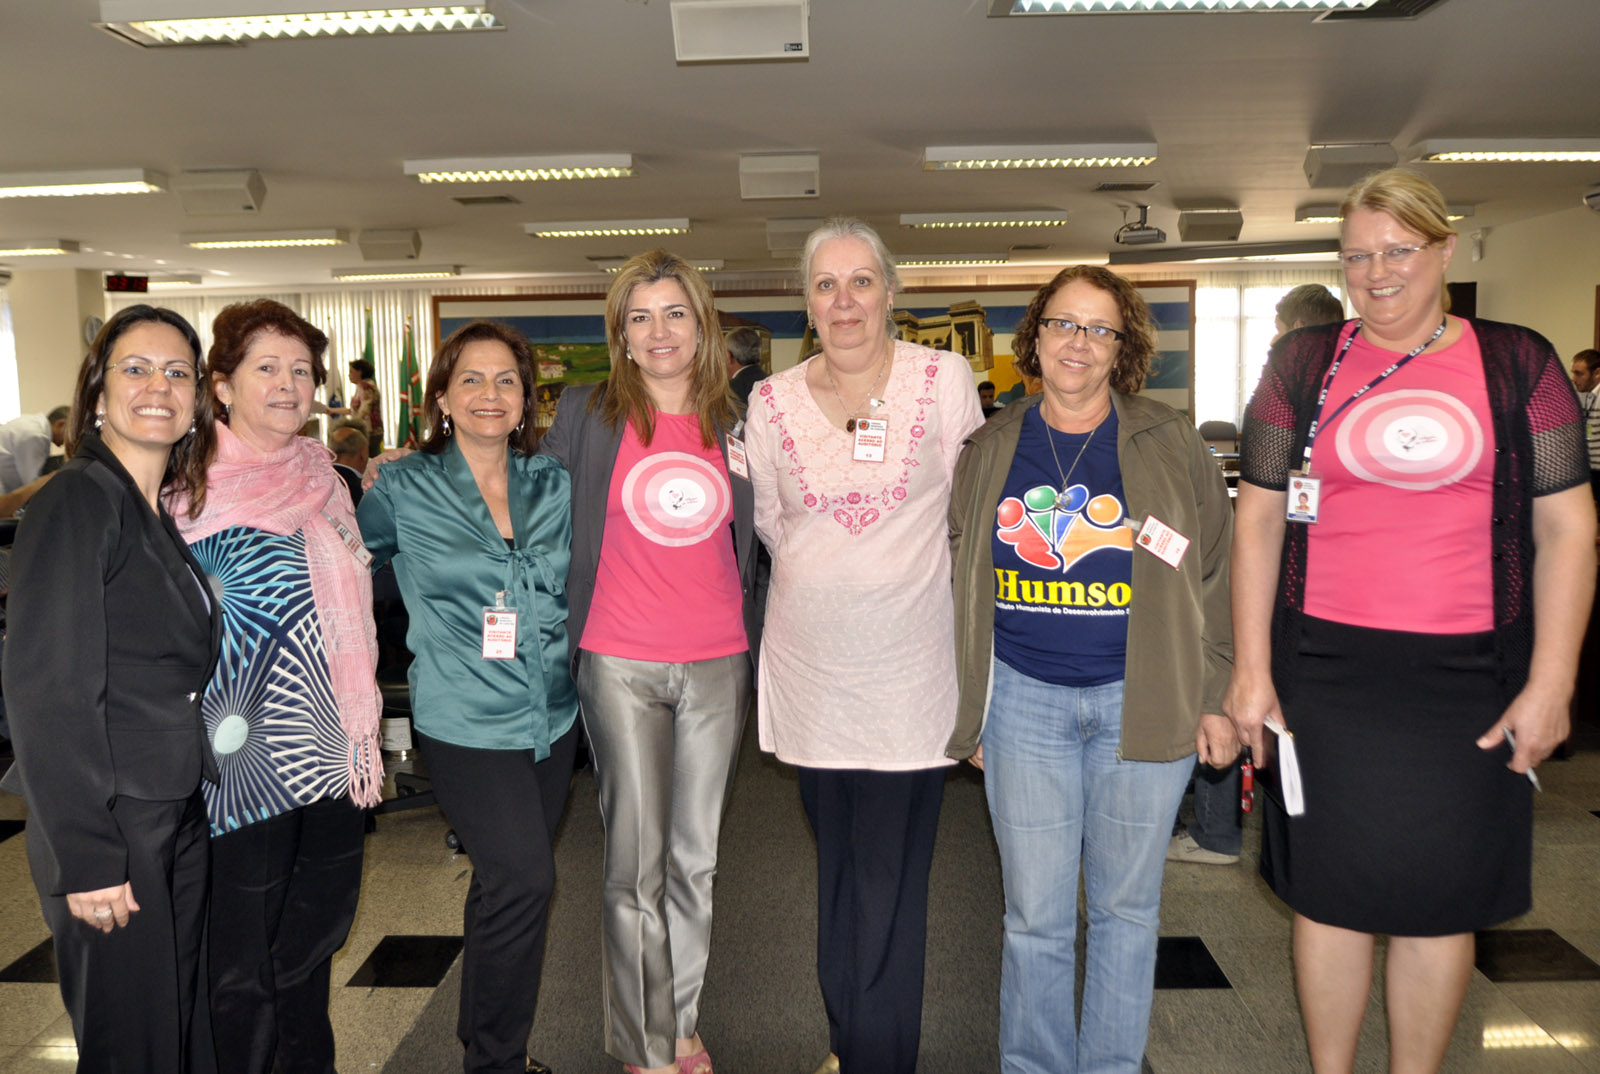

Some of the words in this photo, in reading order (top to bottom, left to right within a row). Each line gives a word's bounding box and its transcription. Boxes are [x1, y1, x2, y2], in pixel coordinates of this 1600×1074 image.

[994, 567, 1131, 607] Humso
[1015, 603, 1052, 614] Humanista
[1052, 606, 1062, 614] de
[1062, 606, 1125, 616] Desenvolvimento
